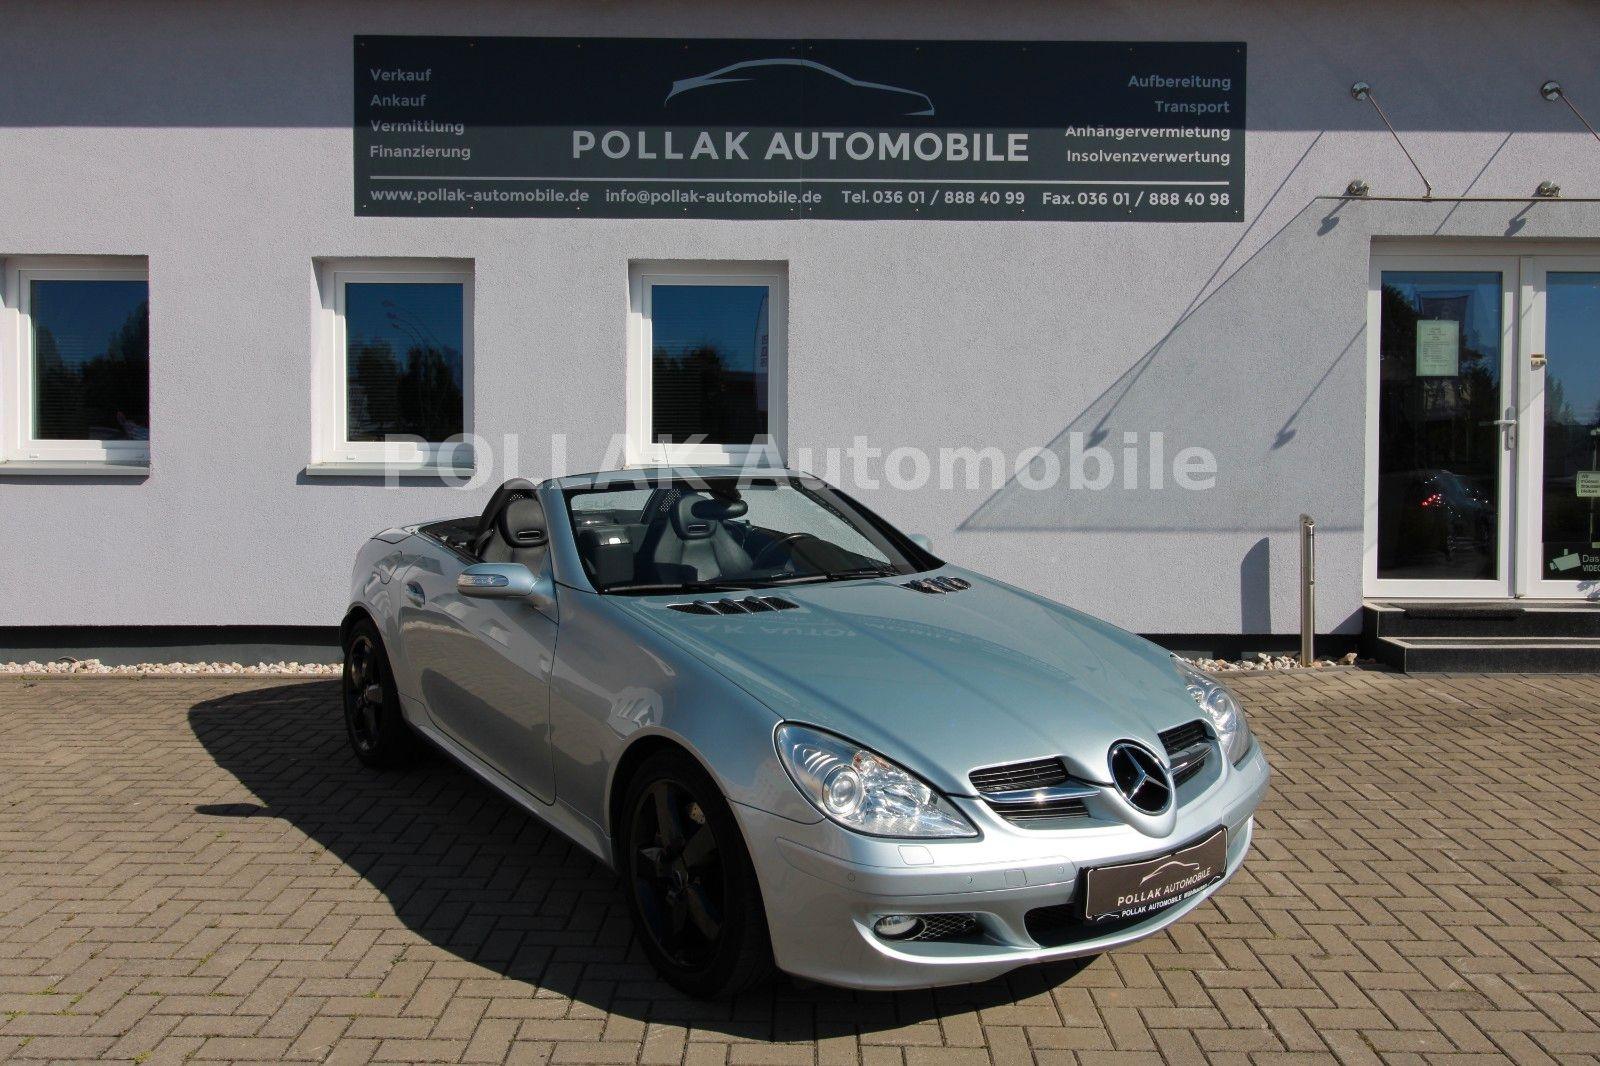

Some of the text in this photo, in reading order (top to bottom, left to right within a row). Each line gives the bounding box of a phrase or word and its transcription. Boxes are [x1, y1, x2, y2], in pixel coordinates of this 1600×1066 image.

[370, 68, 432, 82] Verkauf
[1128, 75, 1231, 92] Aufbereitung
[370, 93, 427, 107] Ankauf
[1155, 100, 1230, 116] Transport
[370, 119, 465, 136] Vermittlung
[1065, 124, 1231, 142] Anhängervermietung
[370, 144, 471, 161] Finanzierung
[573, 130, 1029, 162] POLLAK AUTOMOBILE
[1067, 149, 1231, 167] Insolvenzverwertung
[370, 187, 590, 204] www.pollak-automobile.de
[605, 187, 822, 206] info@pollak-automobile.de
[908, 191, 925, 204] 01
[944, 191, 975, 204] 888
[979, 191, 1000, 205] 40
[1005, 192, 1025, 205] 99
[1112, 193, 1130, 206] 01
[1149, 192, 1180, 206] 888
[1184, 193, 1205, 206] 40
[1209, 193, 1230, 206] 98
[1117, 867, 1211, 907] POLLAK AUTOMOBILE
[1121, 905, 1147, 918] POLLAK
[1148, 894, 1182, 910] AUTOMOBILE
